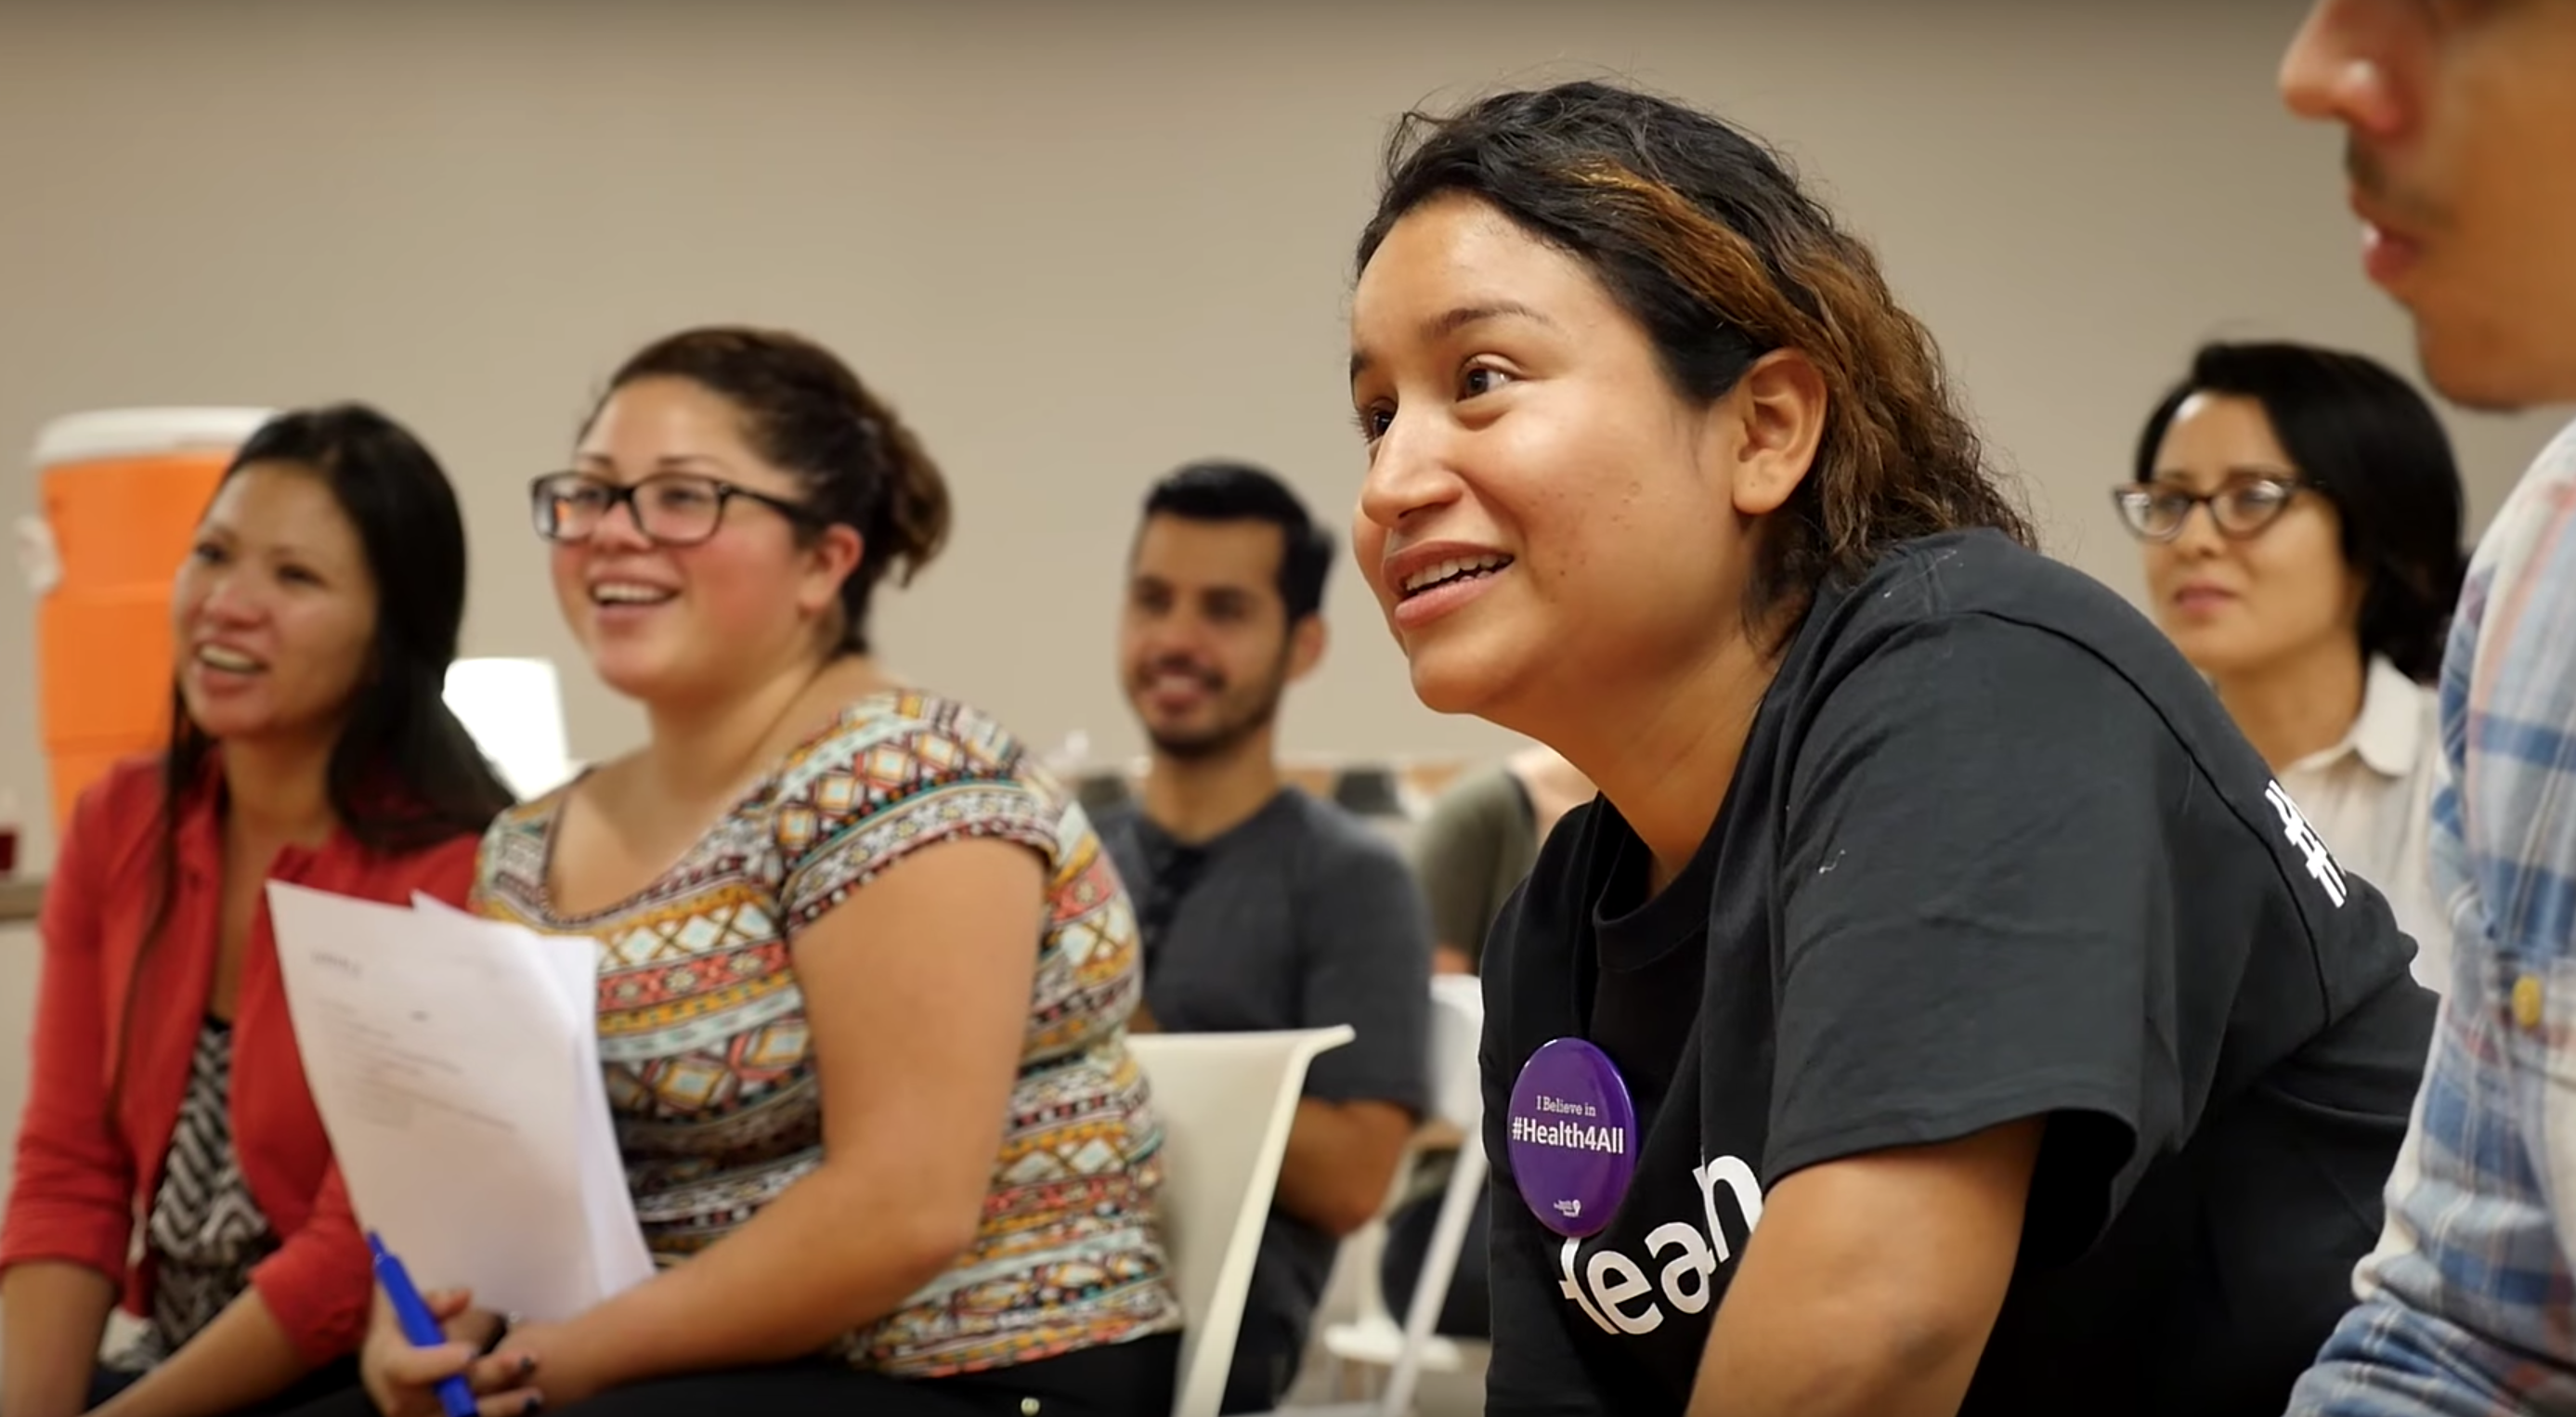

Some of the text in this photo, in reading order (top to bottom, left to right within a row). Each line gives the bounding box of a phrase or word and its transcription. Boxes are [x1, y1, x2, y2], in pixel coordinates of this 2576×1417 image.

[1536, 1095, 1596, 1117] I Believe in
[1511, 1116, 1624, 1154] #Health4All
